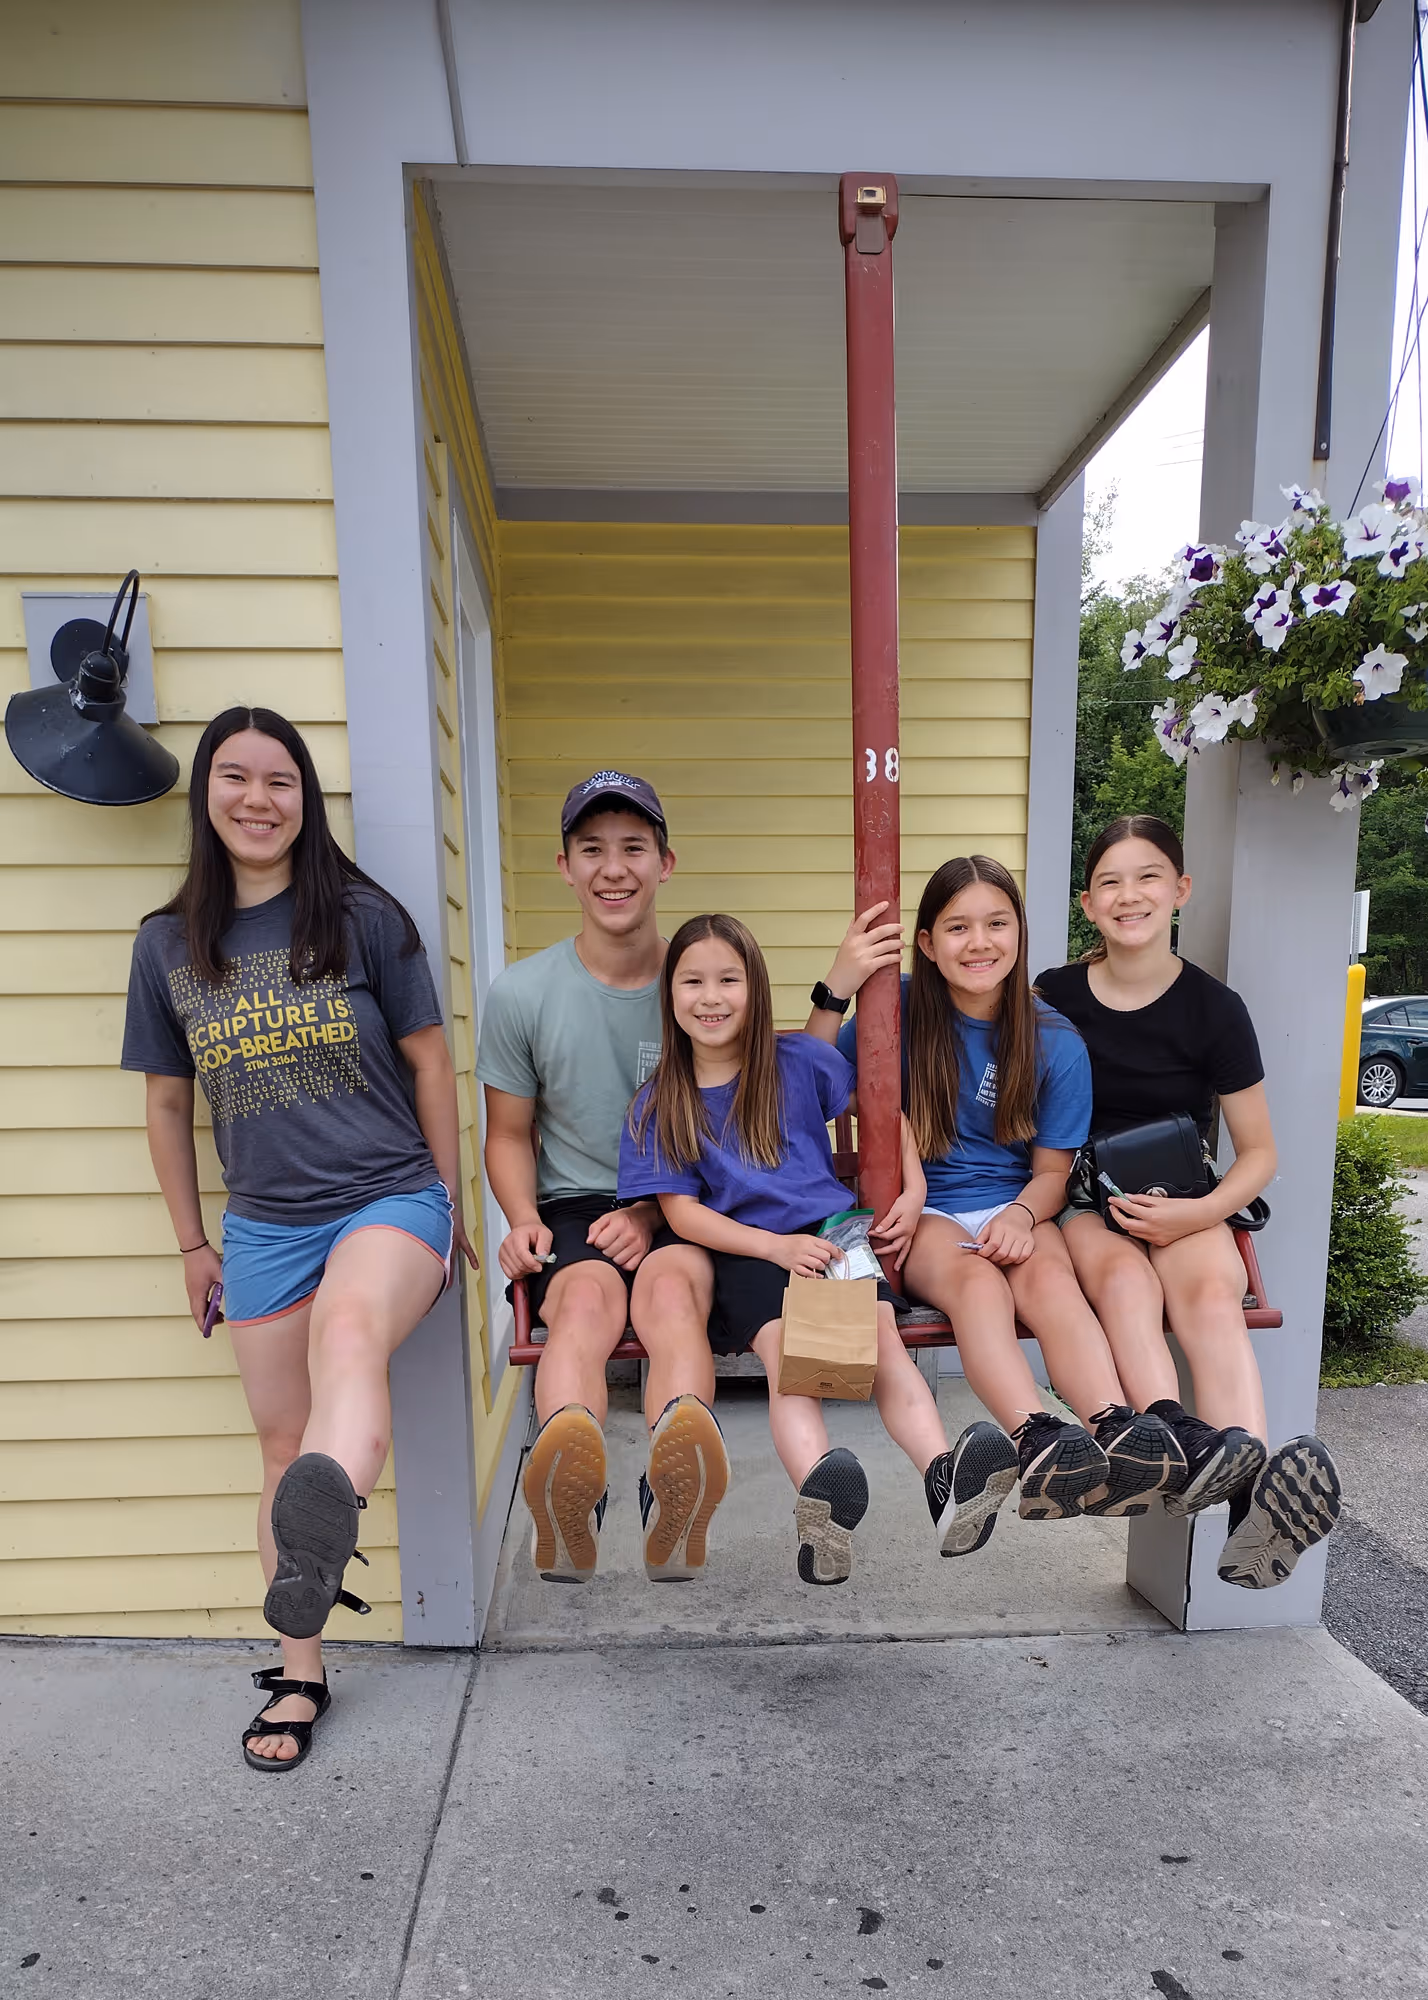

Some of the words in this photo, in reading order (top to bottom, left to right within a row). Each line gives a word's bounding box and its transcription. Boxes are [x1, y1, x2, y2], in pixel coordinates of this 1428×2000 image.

[865, 747, 900, 783] 38
[247, 948, 291, 960] LEVITICU
[252, 954, 287, 965] JOSHU
[267, 959, 291, 968] SECO
[234, 989, 282, 1014] ALL
[189, 1002, 319, 1053] SCRIPTURE
[326, 999, 349, 1020] IS
[196, 1021, 355, 1074] GOD-BREATHED
[302, 1043, 360, 1056] PHILIPPIANS
[244, 1058, 270, 1072] 2TIM
[270, 1053, 298, 1067] 3:16A
[273, 1070, 314, 1083] SECOND
[282, 1074, 328, 1088] HEBREWS
[259, 1087, 298, 1101] SECOND
[304, 1079, 334, 1091] PETER
[273, 1094, 298, 1104] JOHN
[308, 1086, 335, 1097] THIRD
